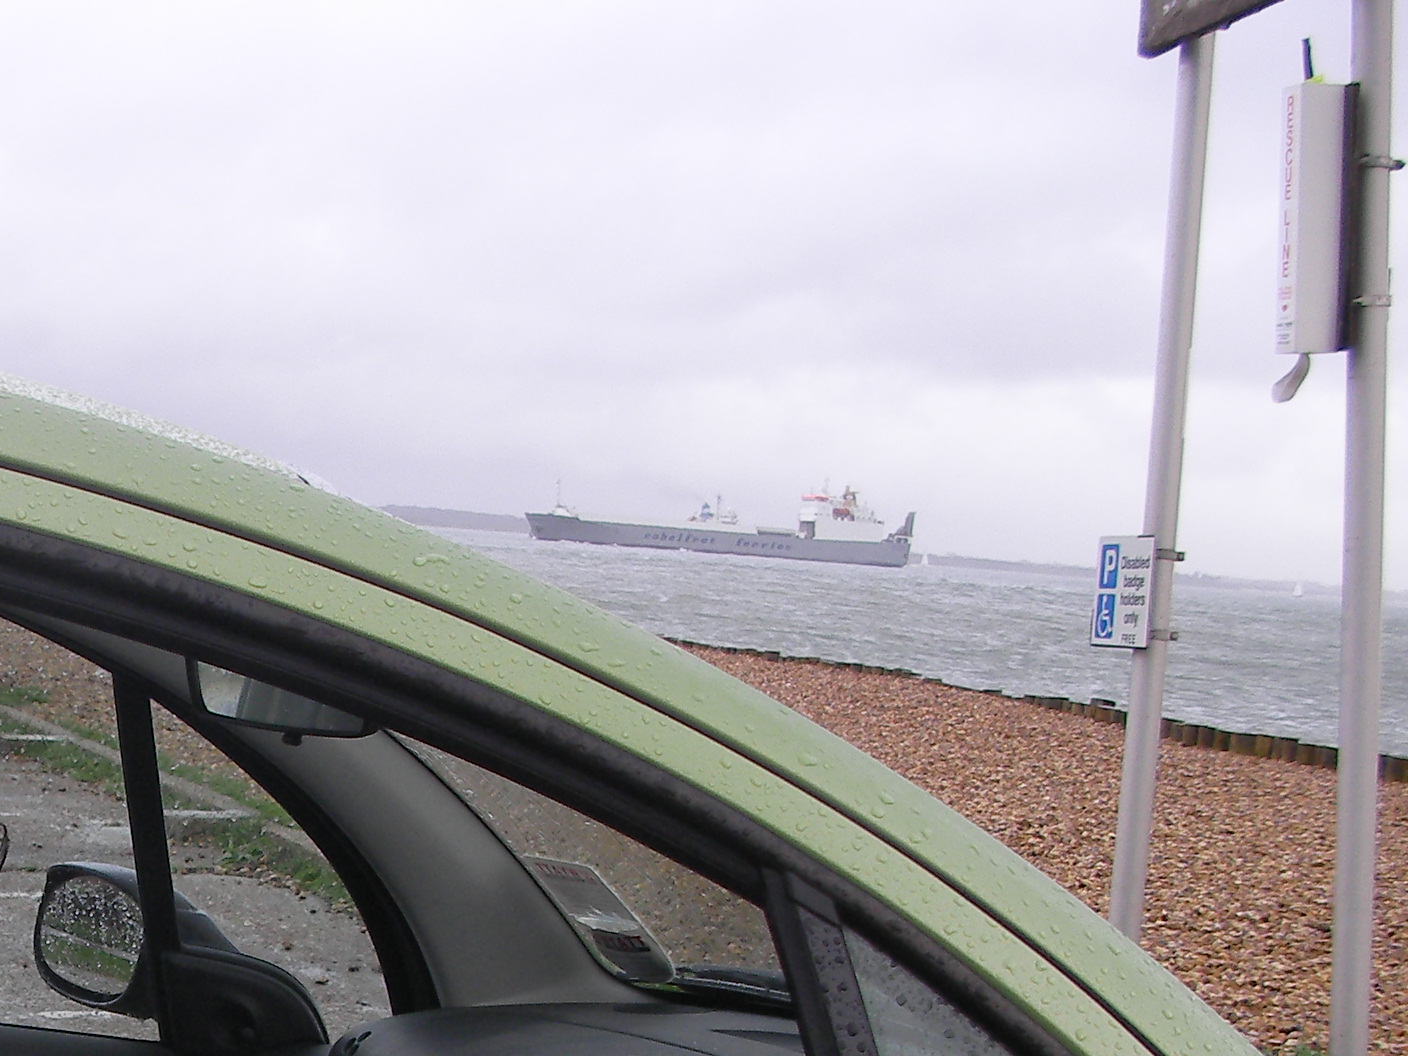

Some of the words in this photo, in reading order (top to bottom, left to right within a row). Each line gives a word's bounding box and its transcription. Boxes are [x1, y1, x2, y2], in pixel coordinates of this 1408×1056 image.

[1284, 95, 1295, 200] RESCUE
[1282, 210, 1291, 278] LINE
[735, 537, 792, 551] ferries
[1103, 549, 1117, 585] P
[1121, 555, 1151, 570] Disabled
[1123, 574, 1145, 591] badge
[1119, 592, 1146, 606] holders
[1123, 610, 1139, 628] only
